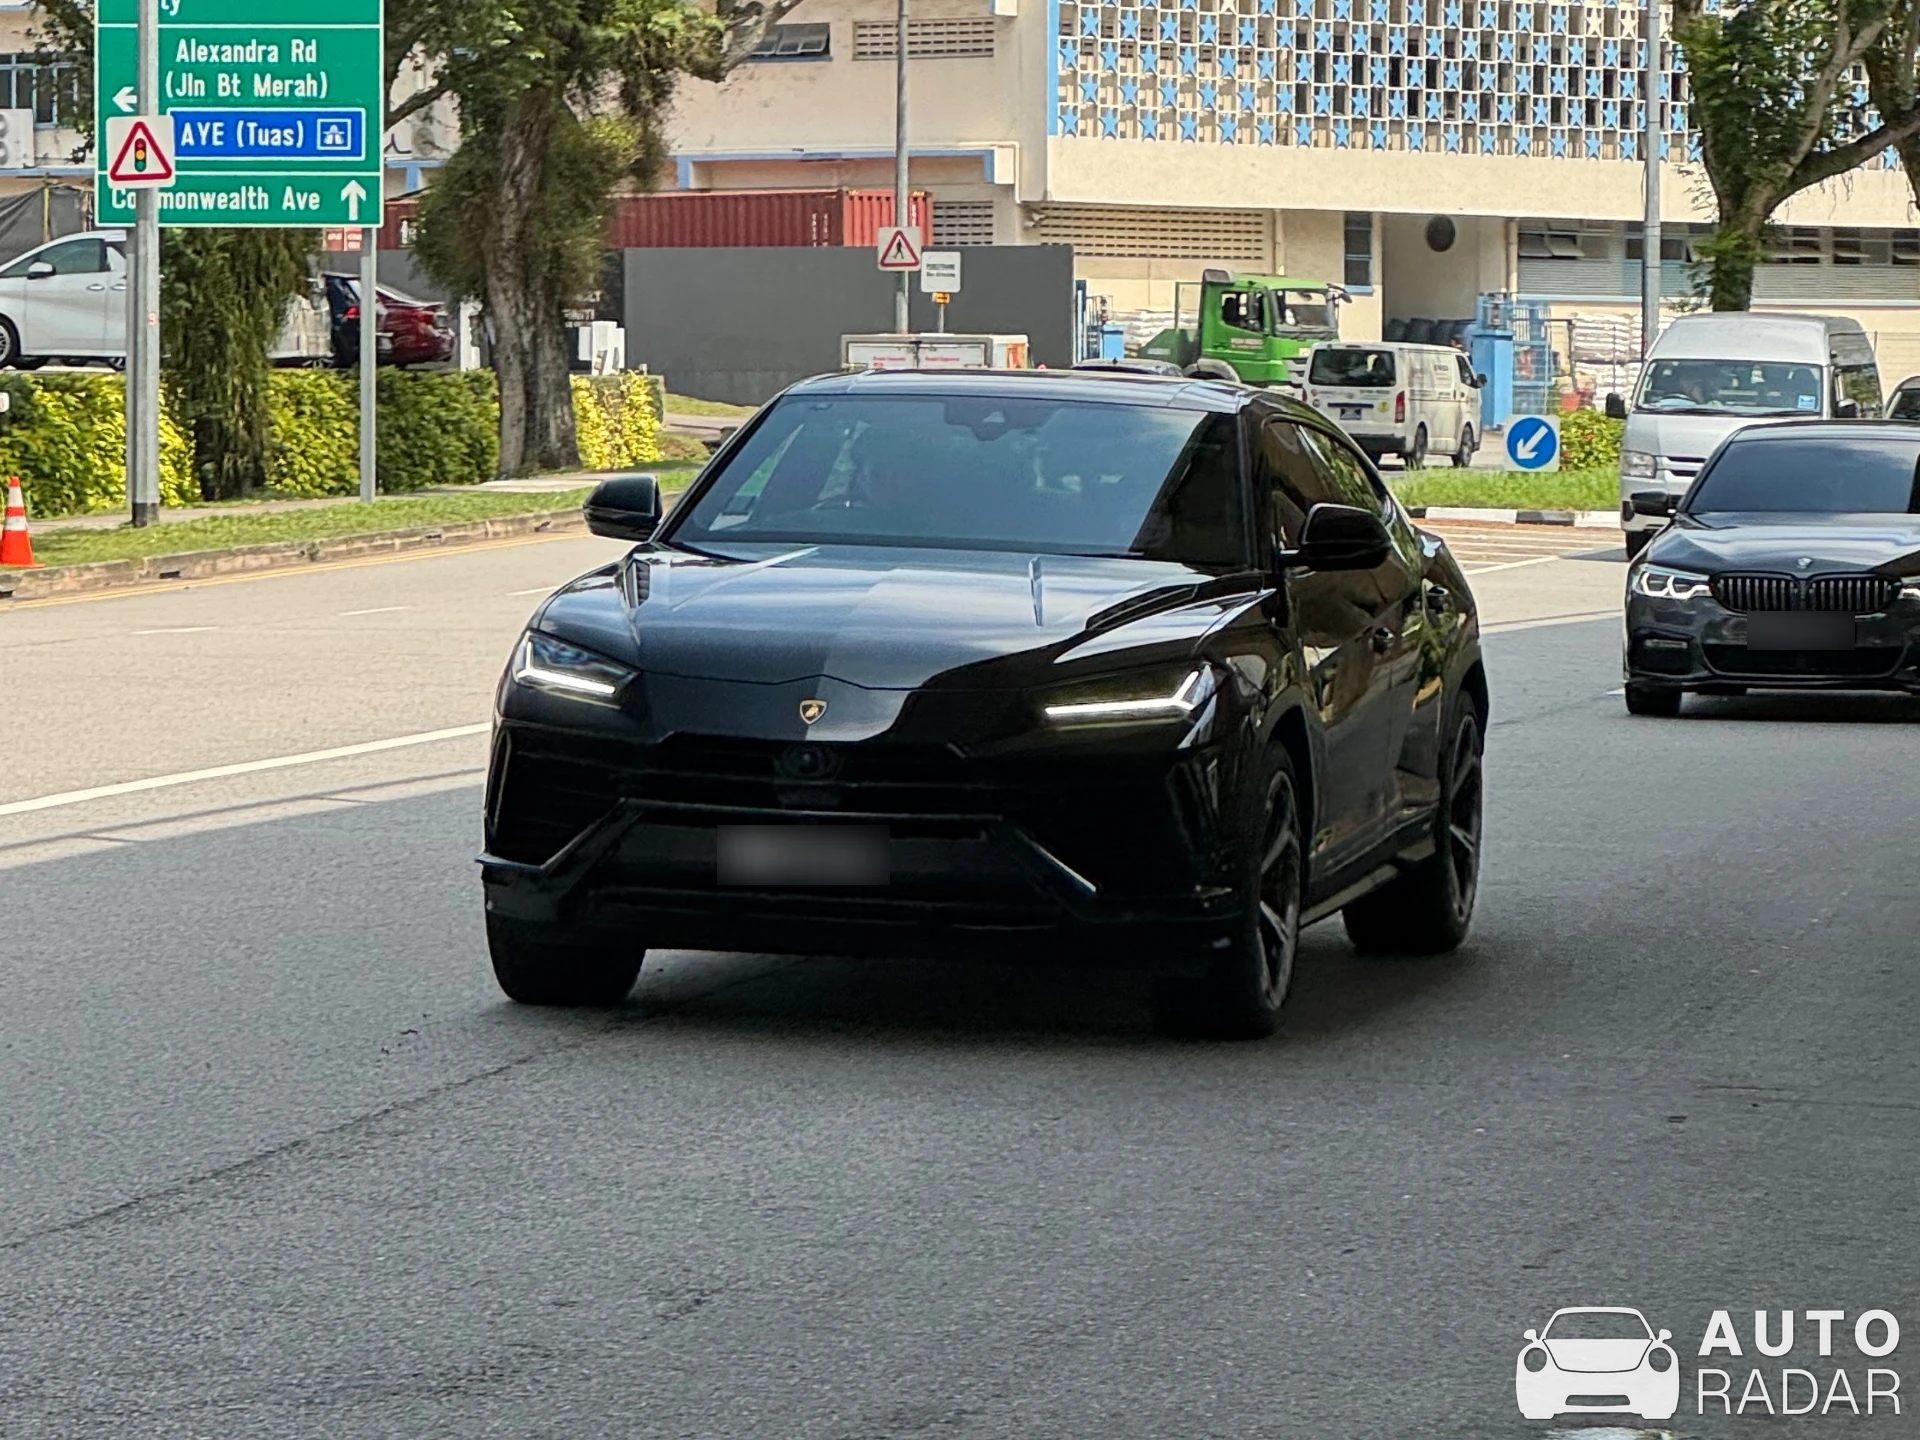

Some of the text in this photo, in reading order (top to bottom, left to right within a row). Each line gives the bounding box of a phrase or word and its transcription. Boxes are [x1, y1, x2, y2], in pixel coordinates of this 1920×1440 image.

[176, 38, 317, 63] Alexandra Rd
[165, 71, 328, 98] (Jln Bt Merah)
[181, 120, 304, 148] AYE (Tuas)
[112, 186, 320, 210] Comonwealth Ave
